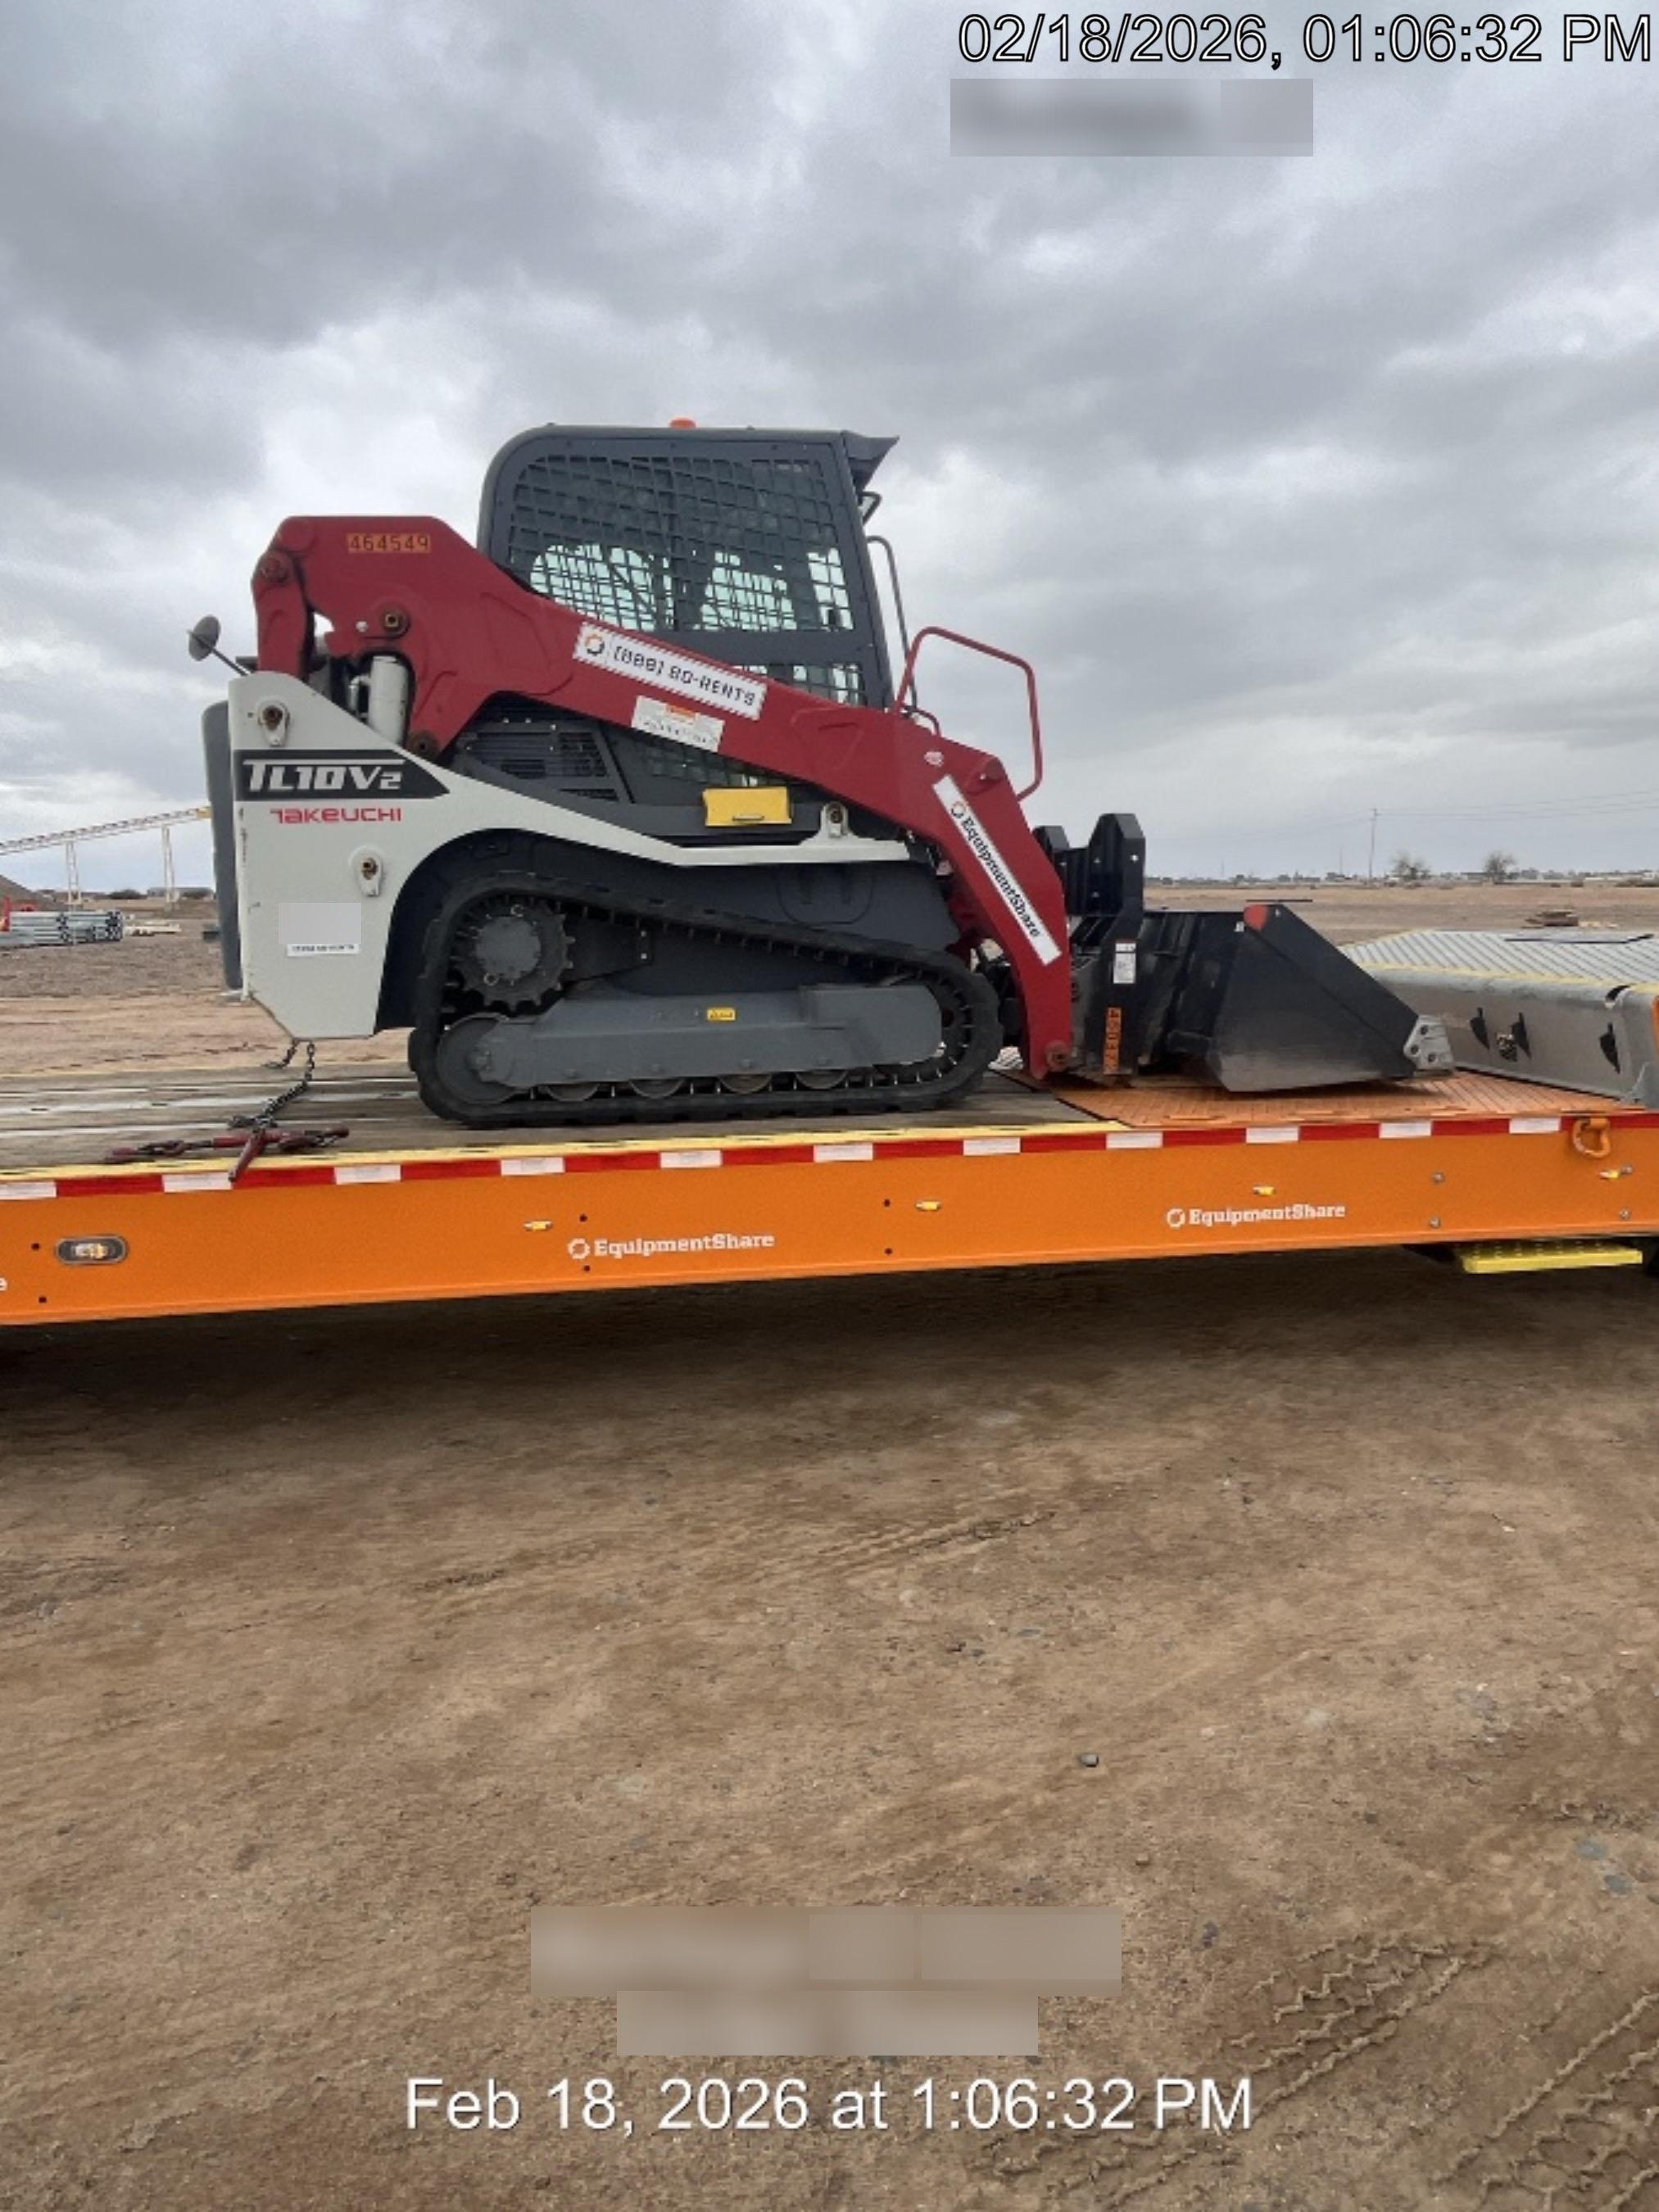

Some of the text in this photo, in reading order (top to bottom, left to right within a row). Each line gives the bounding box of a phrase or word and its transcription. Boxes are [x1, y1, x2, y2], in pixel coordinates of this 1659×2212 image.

[350, 535, 428, 551] 464549
[961, 817, 1040, 938] EquipmentShare
[1188, 1203, 1346, 1226] EquipmentShare
[593, 1233, 775, 1259] EquipmentShare
